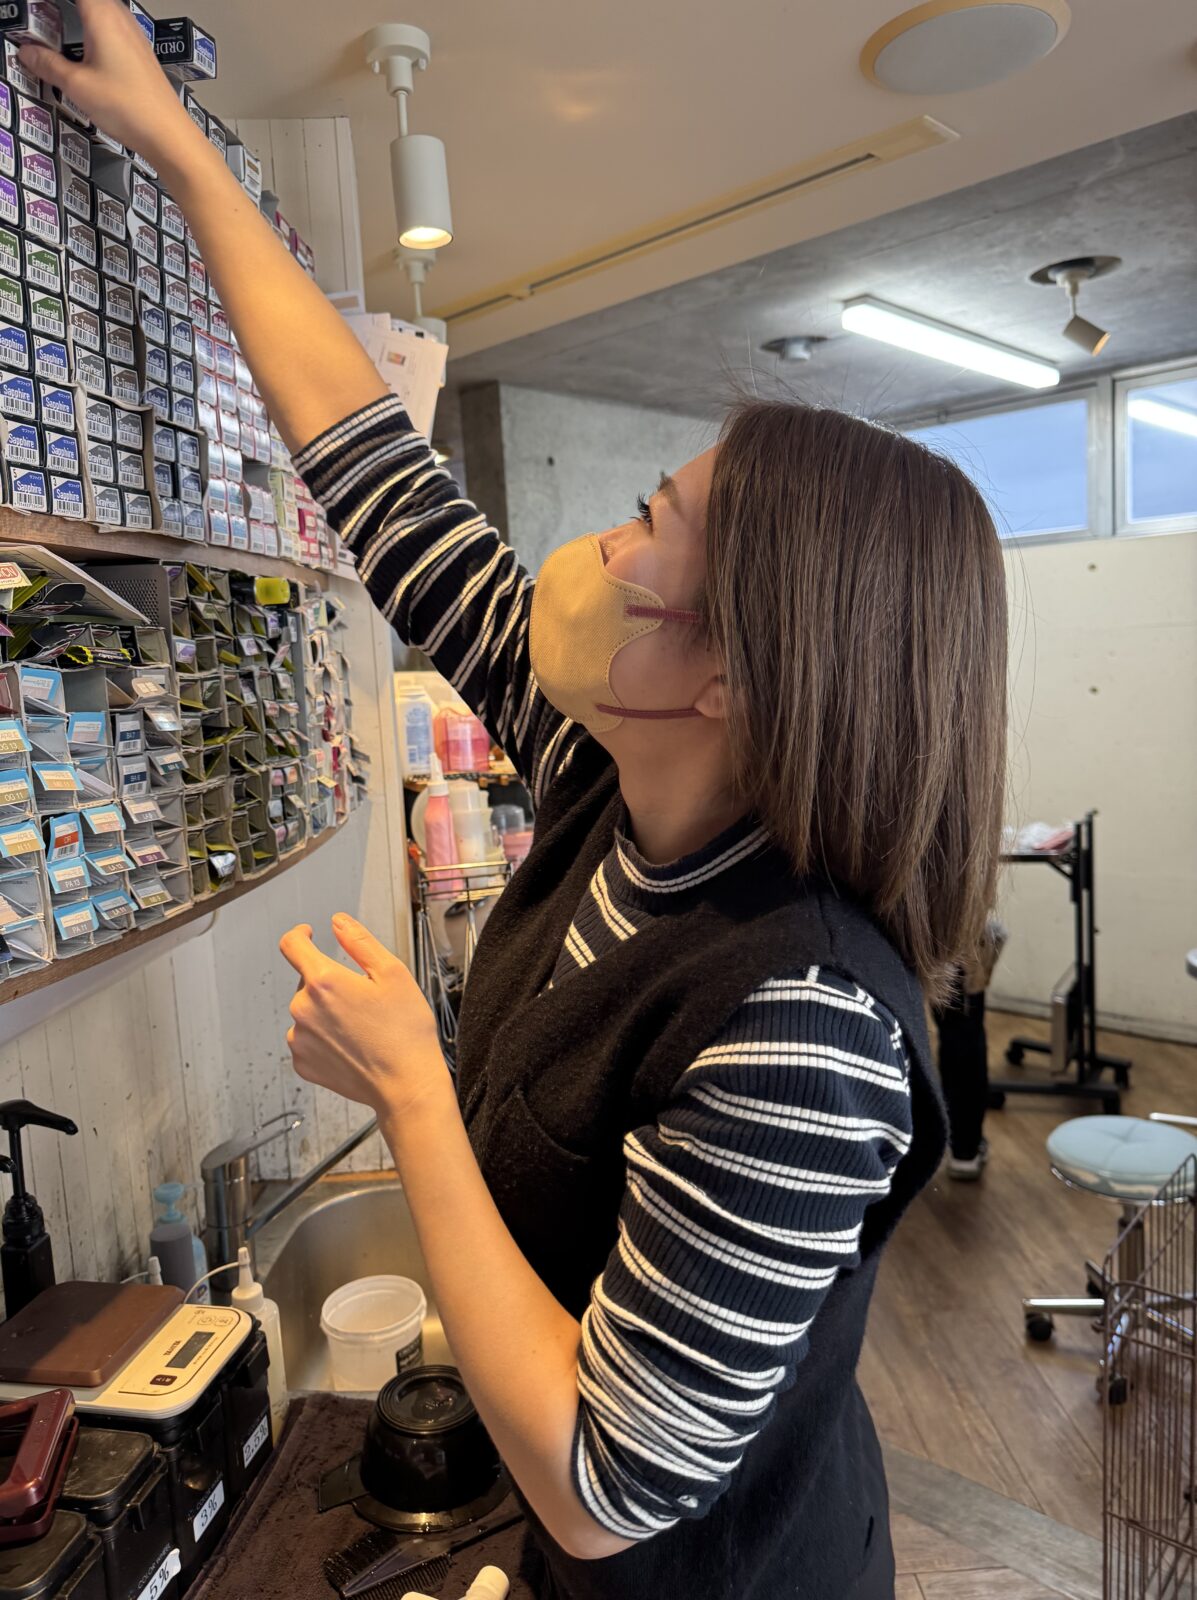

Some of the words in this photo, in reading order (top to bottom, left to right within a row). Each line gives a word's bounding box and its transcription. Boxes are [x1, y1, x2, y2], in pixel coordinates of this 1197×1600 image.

[26, 158, 52, 179] P-Garnet
[68, 184, 87, 203] -Topaz
[30, 204, 56, 225] P-Garnet
[32, 255, 55, 274] Emerald
[74, 273, 96, 291] S-Topaz
[0, 288, 17, 303] merald
[110, 293, 130, 308] S-Topaz
[37, 303, 59, 319] Emerald
[75, 316, 96, 334] S-Topaz
[35, 336, 41, 346] 13
[110, 335, 130, 350] S-Topaz
[40, 350, 64, 366] Sapphire
[115, 377, 136, 391] S-Topaz
[4, 385, 30, 401] Sapphire
[46, 397, 70, 413] Sapphire
[9, 433, 35, 448] Sapphire
[51, 444, 74, 459] Sapphire
[13, 468, 18, 478] 5
[17, 480, 42, 495] Sapphire
[56, 488, 80, 502] Sapphire
[10, 741, 18, 750] 13
[72, 924, 82, 932] PA
[245, 1424, 268, 1461] 2.5%
[201, 1494, 217, 1527] 3%
[150, 1561, 169, 1599] 5%
